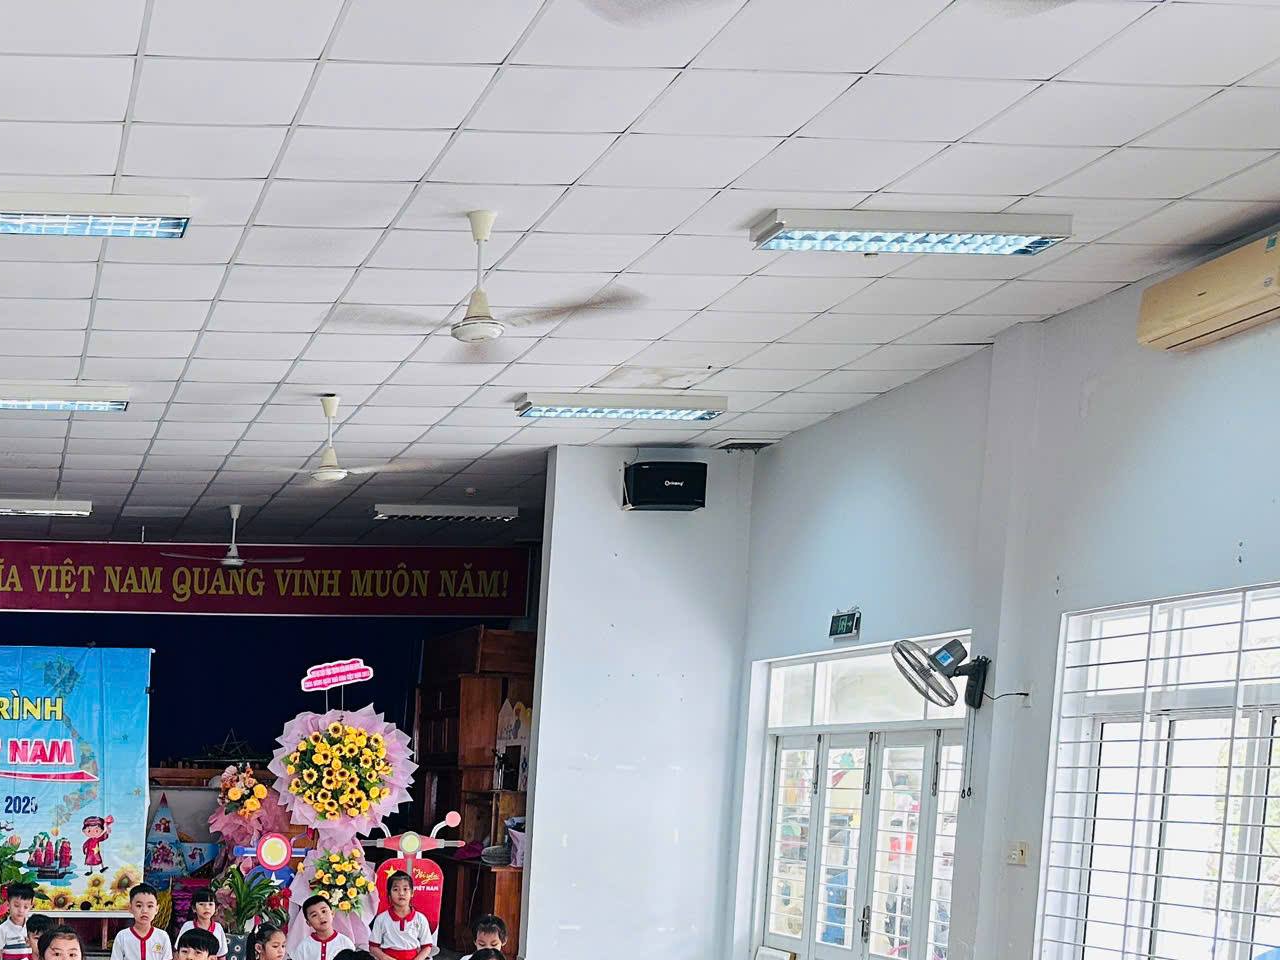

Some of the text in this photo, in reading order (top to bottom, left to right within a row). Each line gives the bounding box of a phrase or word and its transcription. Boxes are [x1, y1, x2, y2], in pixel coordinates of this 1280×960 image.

[30, 557, 96, 599] VIỆT
[103, 566, 164, 593] NAM
[172, 566, 265, 602] QUANG
[274, 569, 341, 597] VINH
[350, 562, 430, 598] MUÔN
[438, 562, 509, 597] NĂM!
[8, 738, 75, 765] NAM
